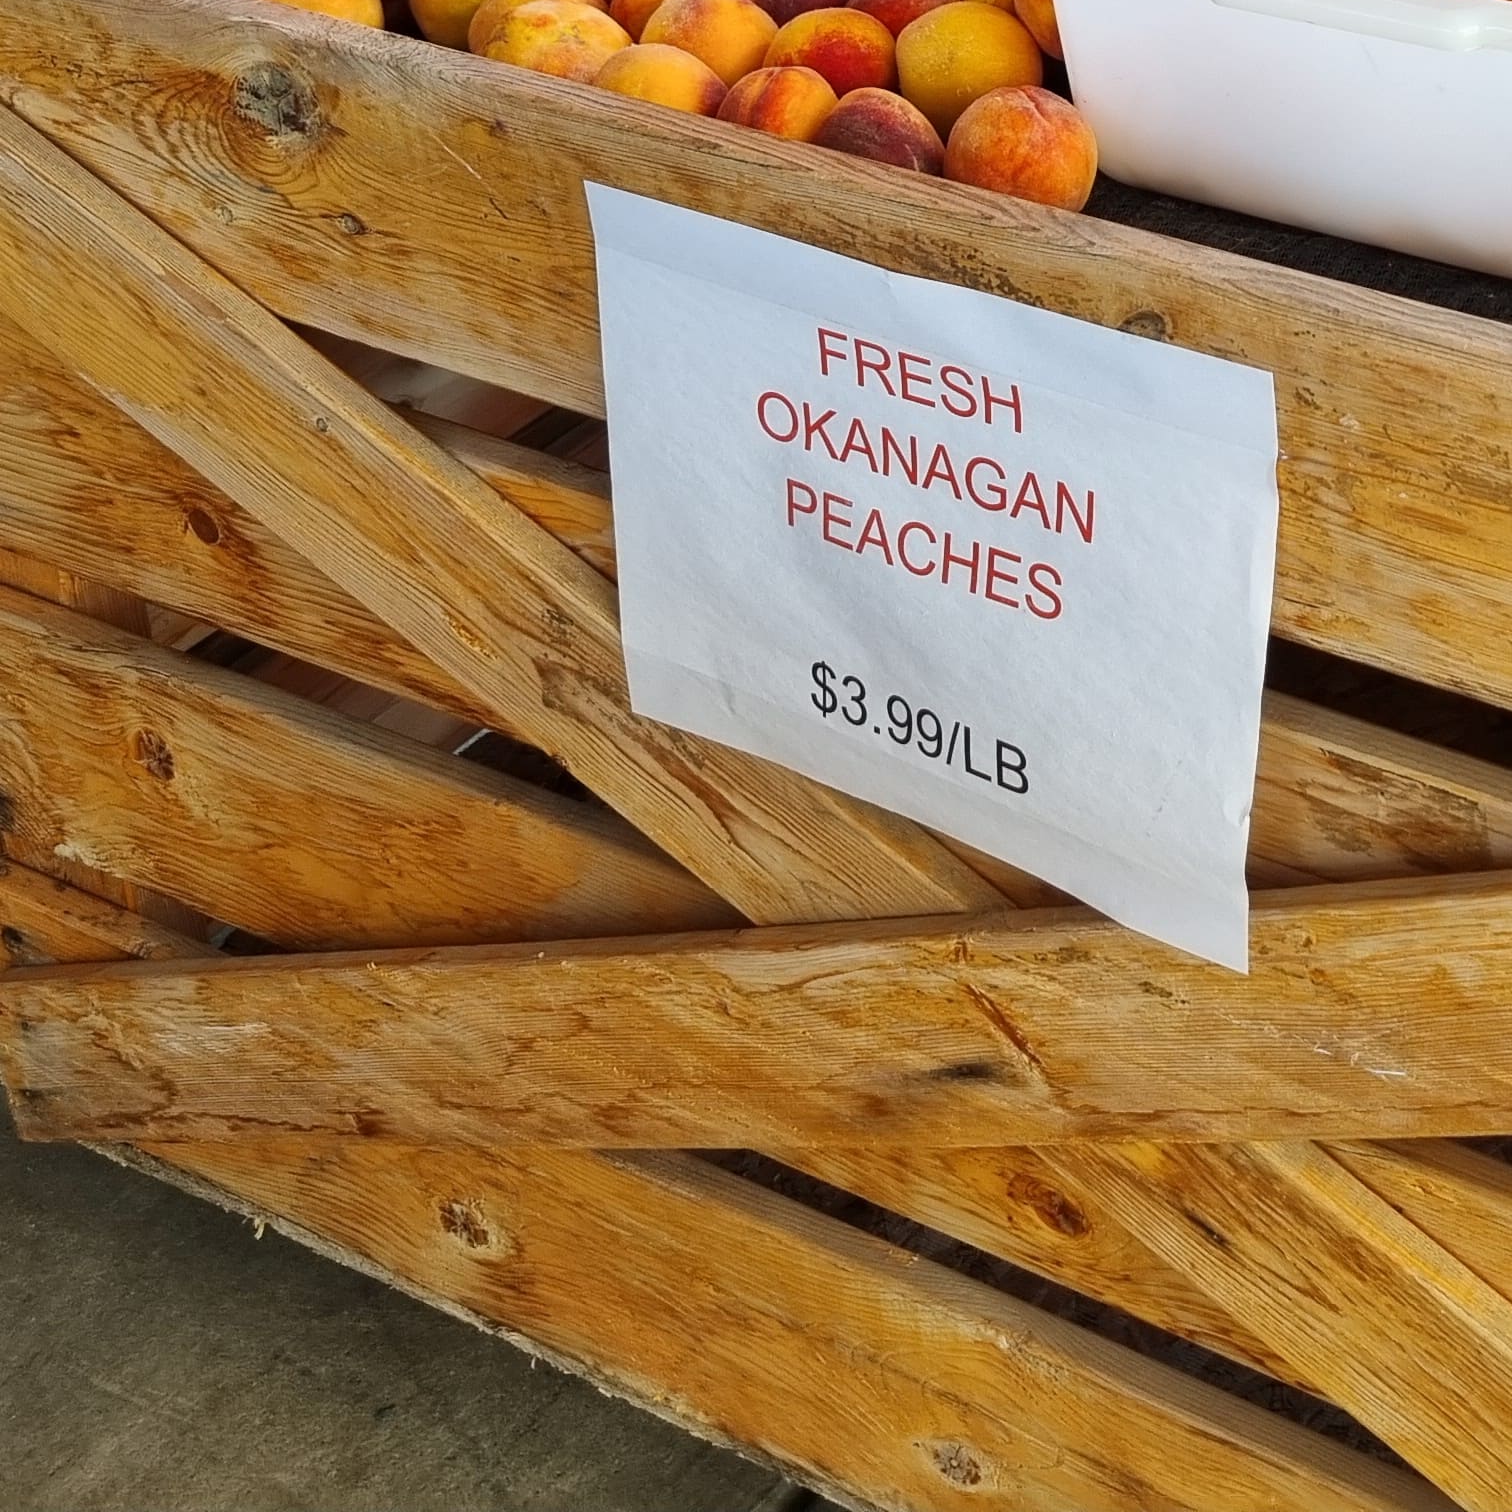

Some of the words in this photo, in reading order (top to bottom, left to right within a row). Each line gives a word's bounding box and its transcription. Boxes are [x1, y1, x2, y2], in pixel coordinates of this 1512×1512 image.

[818, 326, 1023, 433] FRESH
[757, 390, 1096, 544] OKANAGAN
[786, 478, 1063, 620] PEACHES
[810, 660, 1030, 795] $3.99/LB
